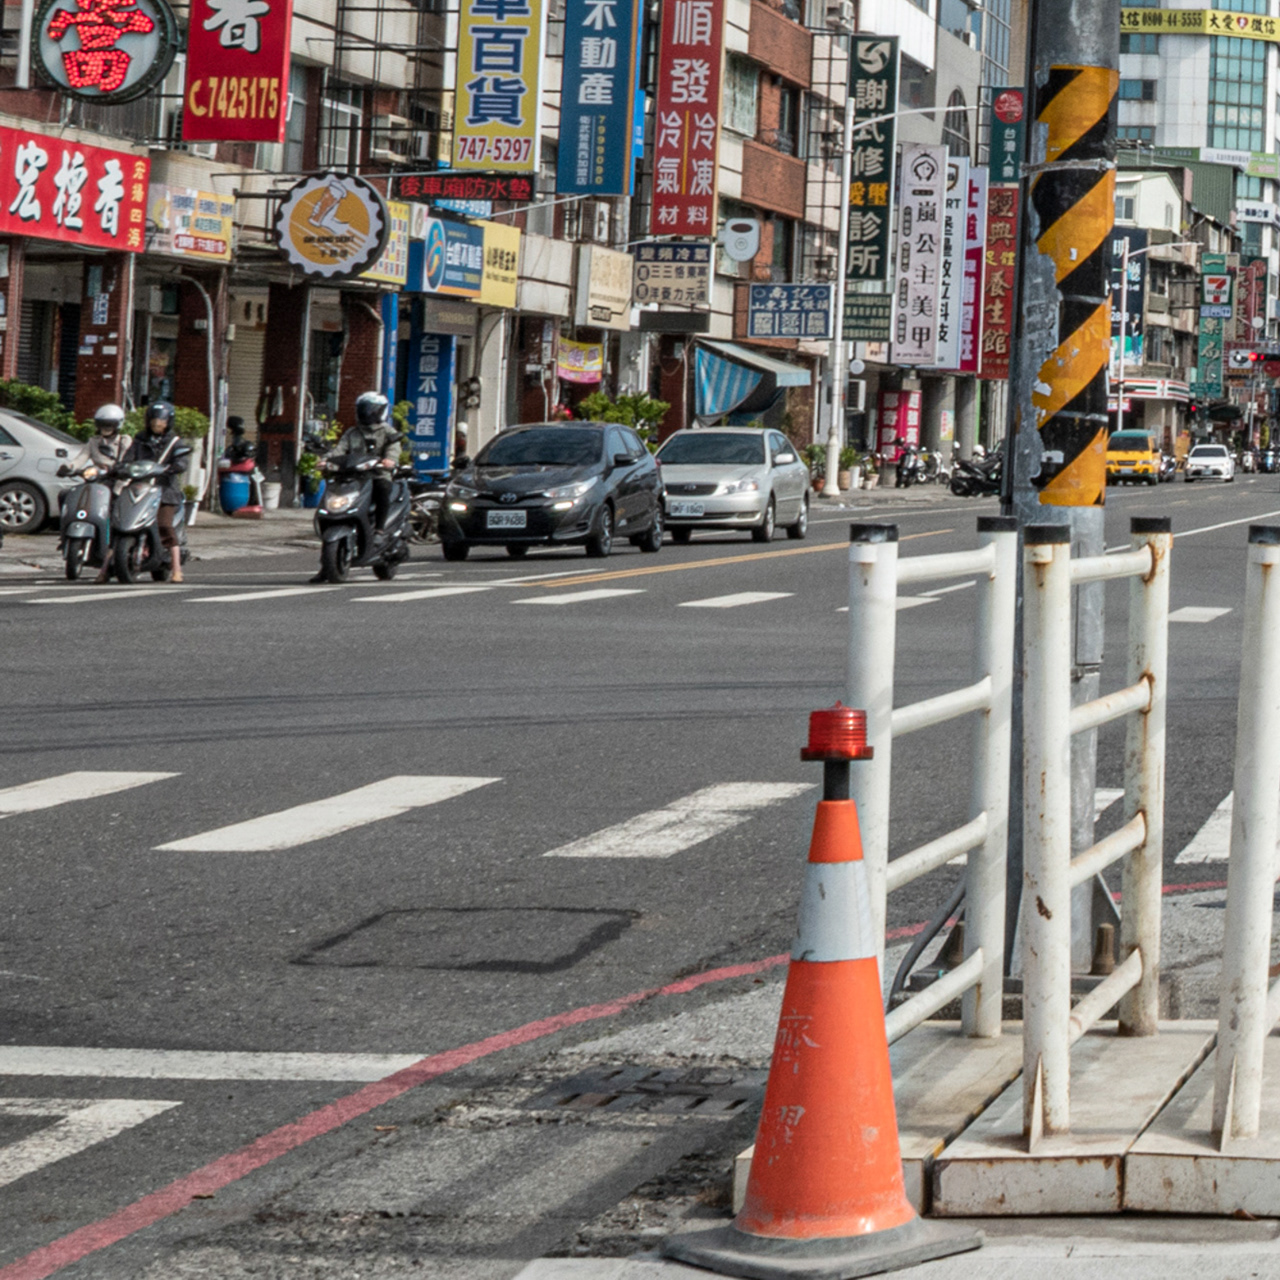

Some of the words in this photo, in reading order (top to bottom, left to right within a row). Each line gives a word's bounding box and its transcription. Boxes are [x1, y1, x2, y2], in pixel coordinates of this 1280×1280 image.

[208, 77, 279, 119] 7425175
[458, 136, 533, 163] 747-5297
[656, 111, 681, 195] 冷氣
[690, 112, 715, 196] 冷凍
[400, 176, 530, 200] 後車廂防水墊
[657, 205, 709, 226] 材料
